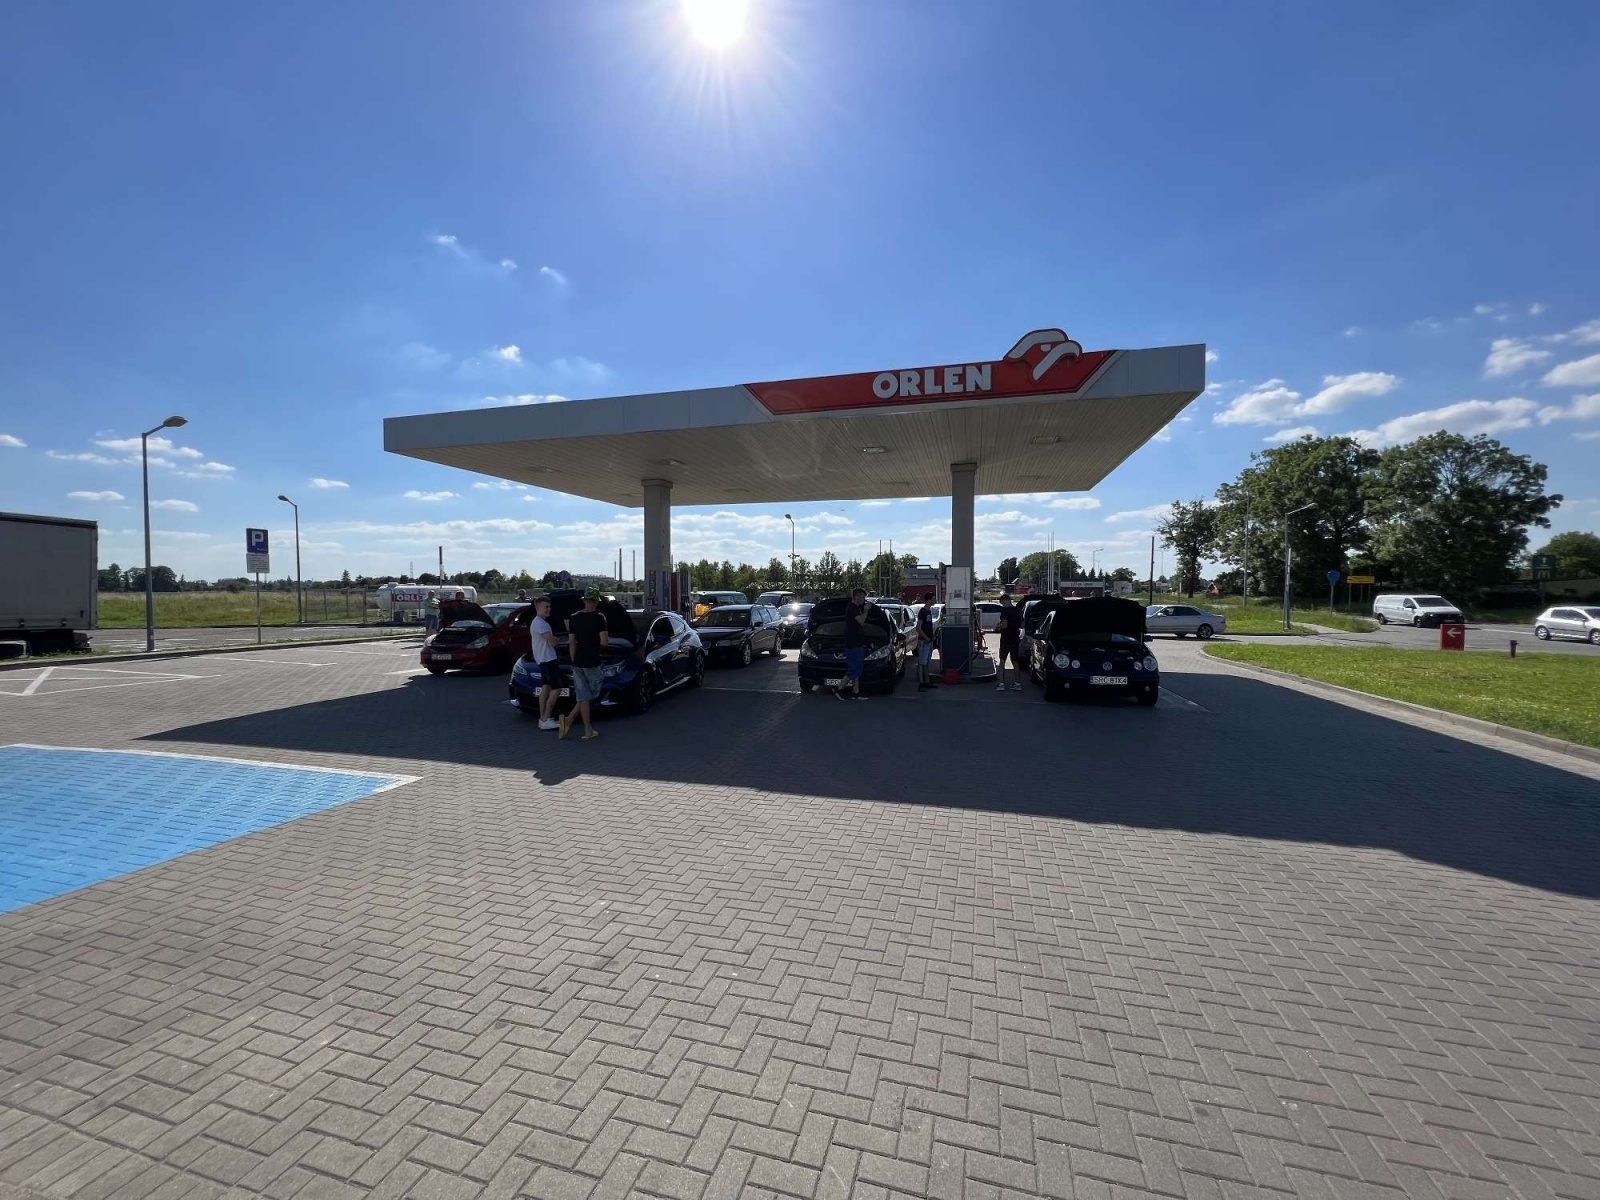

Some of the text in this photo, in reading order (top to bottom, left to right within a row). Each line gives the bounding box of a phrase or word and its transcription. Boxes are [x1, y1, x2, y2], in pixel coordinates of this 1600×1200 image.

[872, 364, 992, 399] ORLEN
[251, 531, 264, 547] P
[396, 594, 424, 602] ORLE
